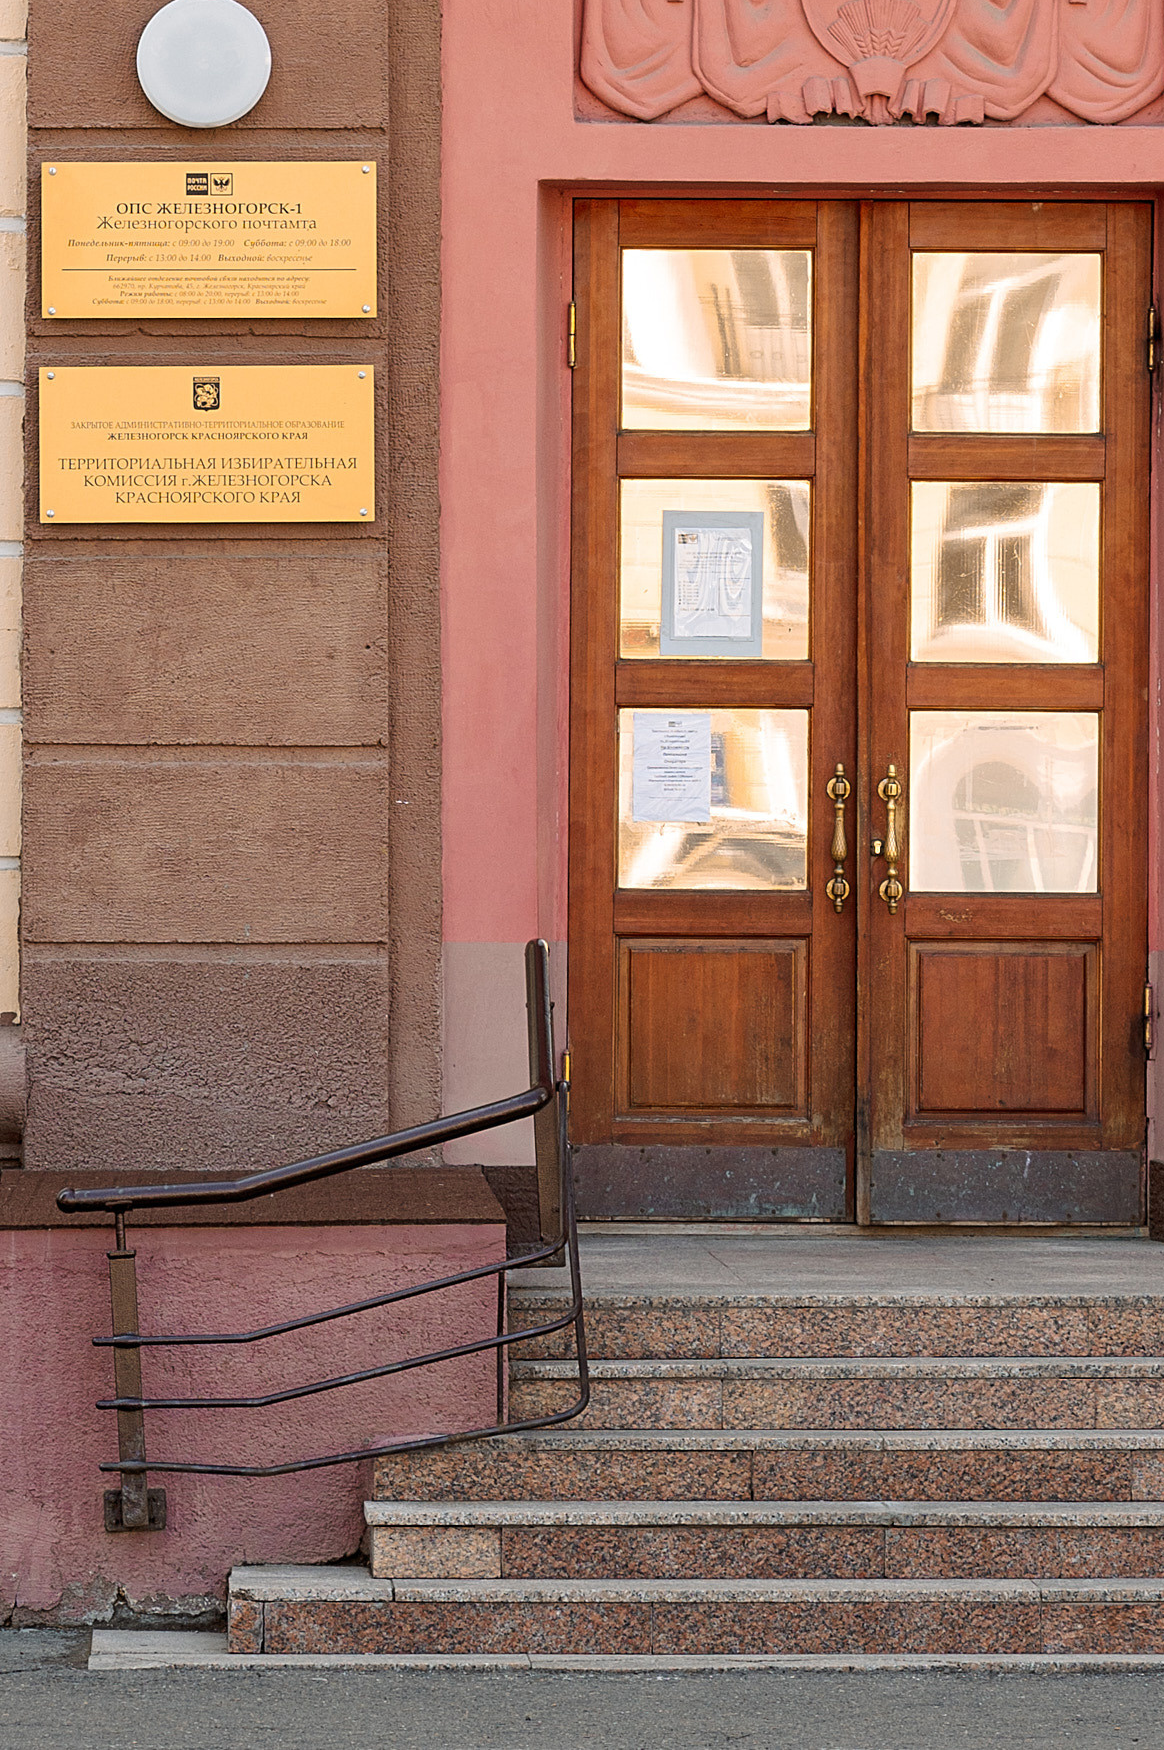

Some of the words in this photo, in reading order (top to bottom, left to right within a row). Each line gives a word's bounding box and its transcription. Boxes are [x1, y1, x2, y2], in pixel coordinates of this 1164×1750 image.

[116, 202, 152, 214] ОПС
[157, 202, 302, 214] ЖЕЛЕЗНОГОРСК-1
[96, 216, 238, 233] Железногорского
[242, 219, 317, 230] почтамта
[67, 239, 170, 249] Понедельник-пятница:
[244, 239, 287, 249] Суббота:
[106, 253, 147, 264] Перерыв:
[218, 253, 266, 262] Выходной:
[107, 432, 189, 441] ЖЕЛЕЗНОГОРСК
[191, 432, 280, 441] КРАСНОЯРСКОГО
[282, 432, 308, 441] КРАЯ
[57, 457, 216, 470] ТЕРРИТОРИАЛЬНАЯ
[221, 457, 357, 470] ИЗБИРАТЕЛЬНАЯ
[83, 474, 176, 487] КОМИССИЯ
[115, 491, 256, 504] КРАСНОЯРСКОГО
[259, 491, 301, 504] КРАЯ
